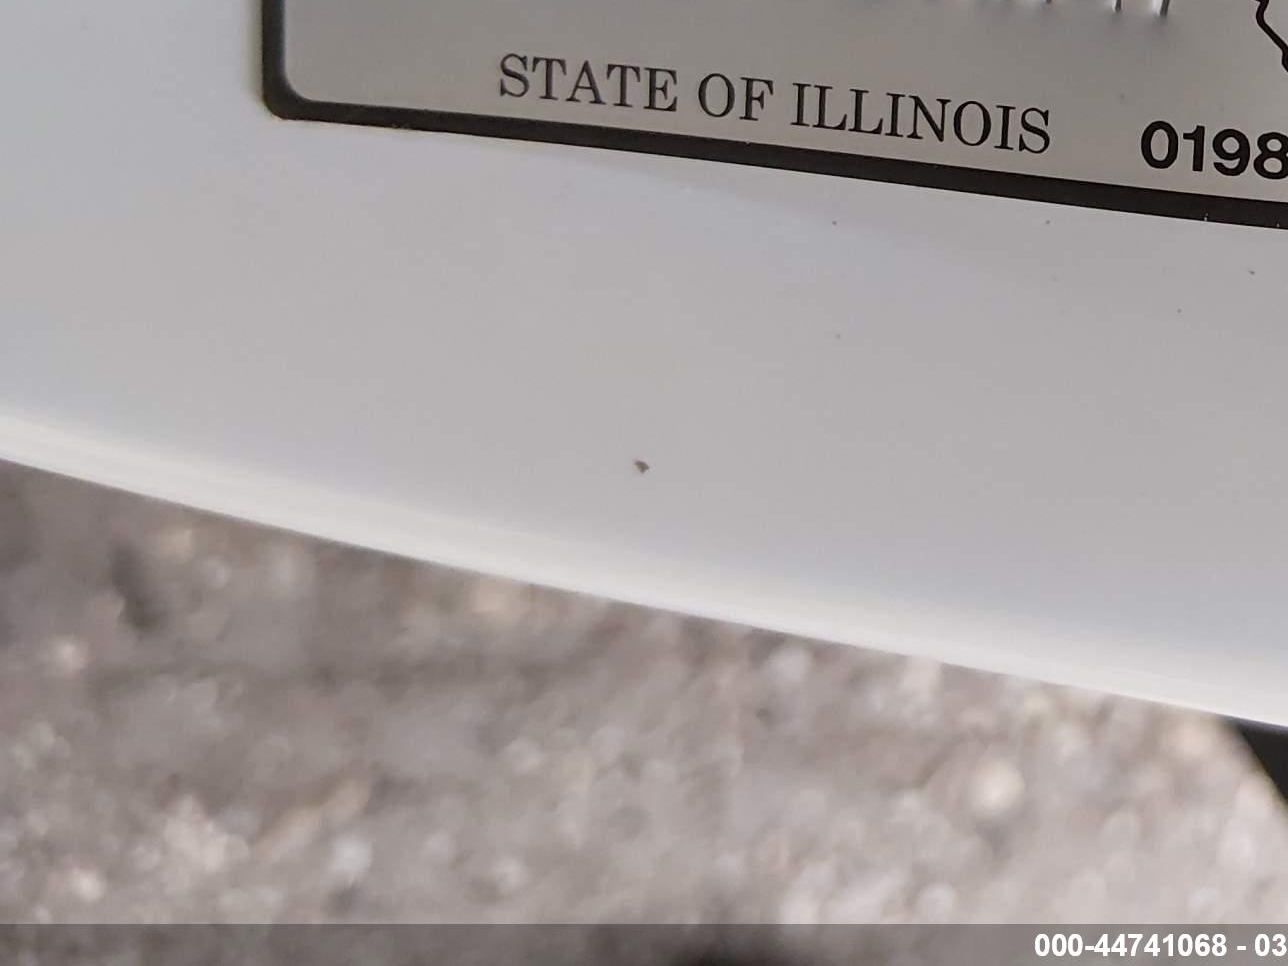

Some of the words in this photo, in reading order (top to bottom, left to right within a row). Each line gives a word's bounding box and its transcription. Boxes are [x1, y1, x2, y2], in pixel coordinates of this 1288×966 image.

[499, 52, 678, 113] STATE
[697, 72, 774, 122] OF
[789, 82, 1051, 155] ILLINOIS
